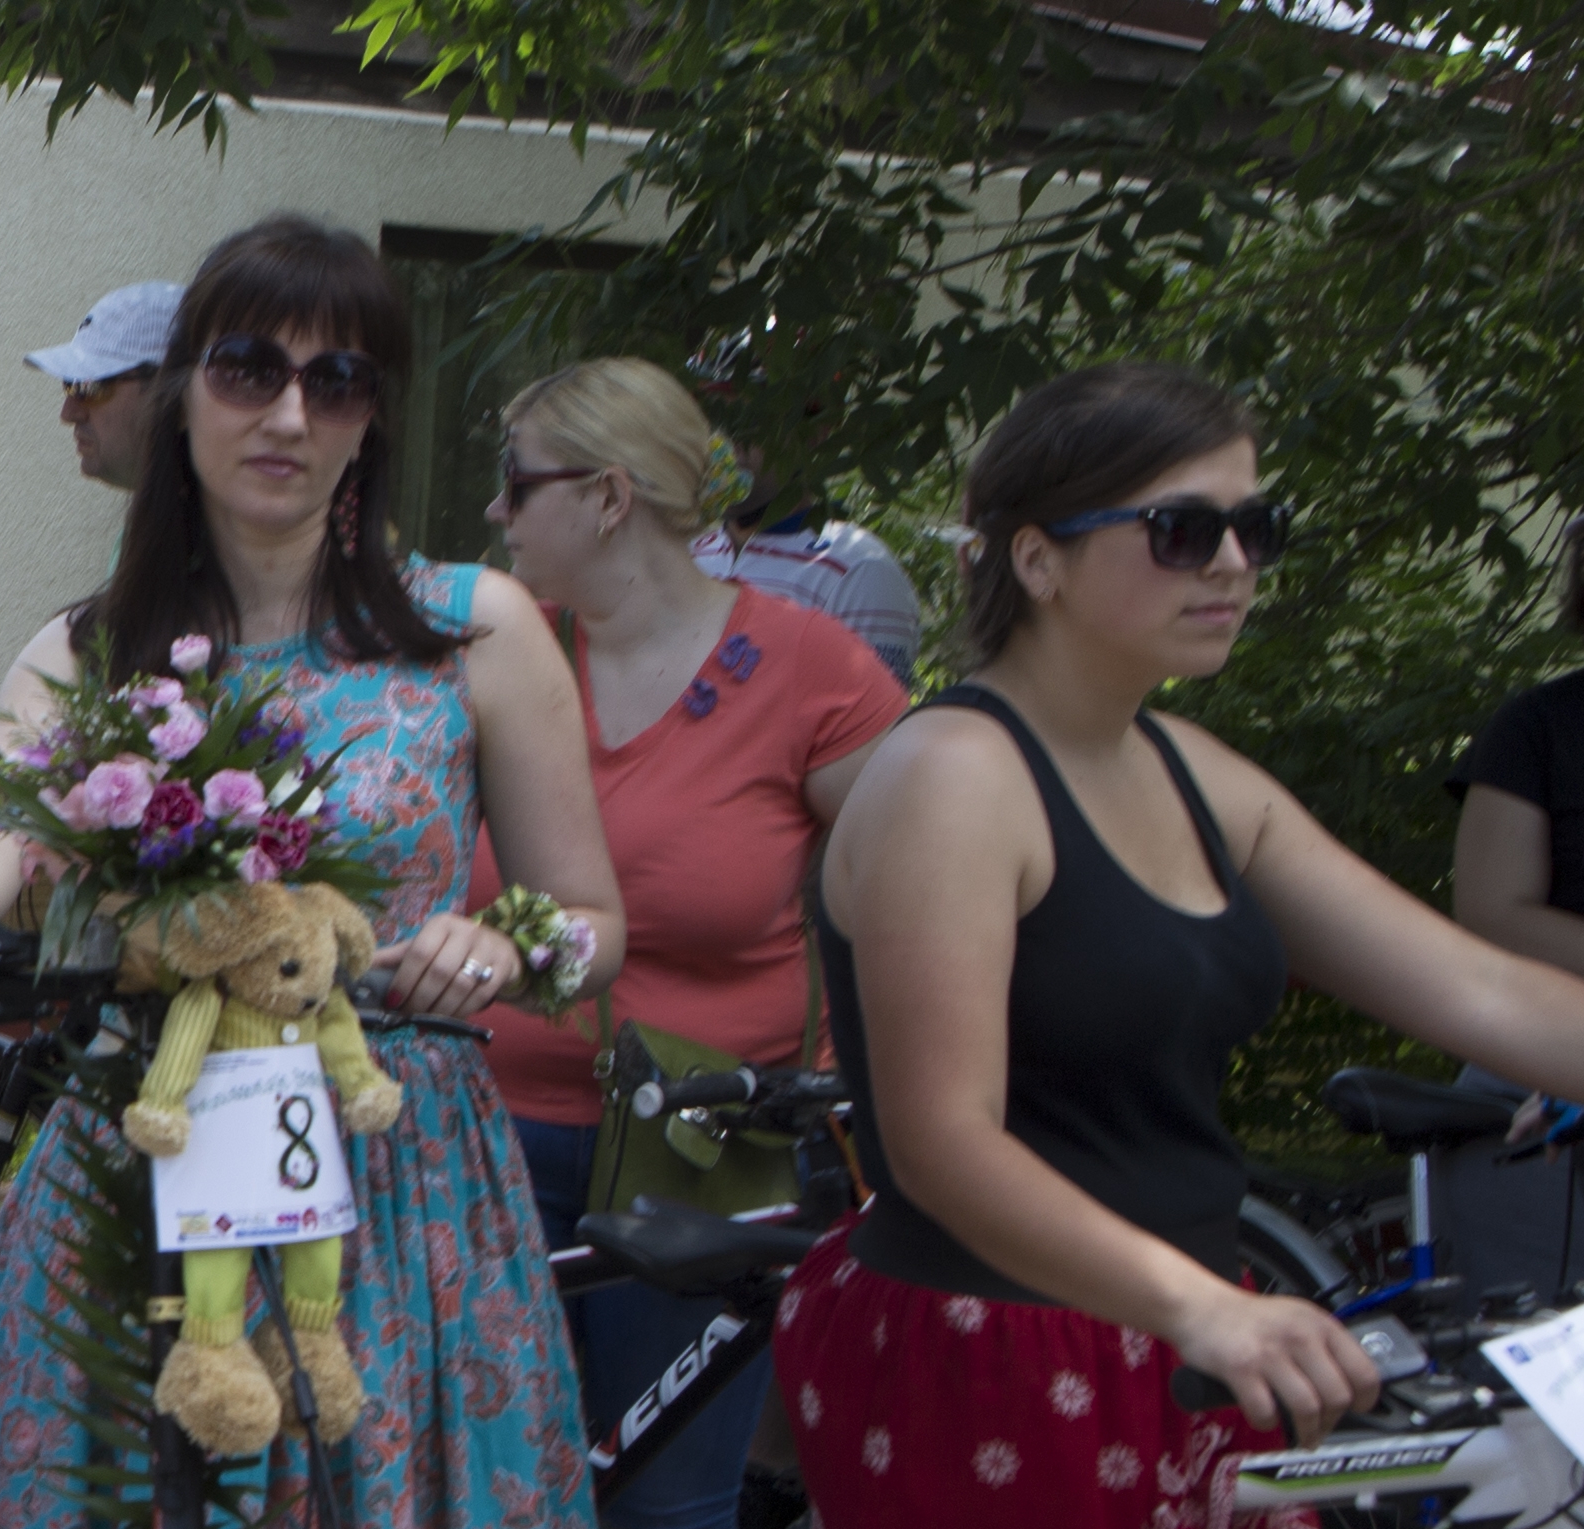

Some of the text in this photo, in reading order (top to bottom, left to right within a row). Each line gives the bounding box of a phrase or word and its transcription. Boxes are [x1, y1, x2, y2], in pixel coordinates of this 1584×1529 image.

[277, 1095, 320, 1191] 8
[1276, 1447, 1449, 1480] PRO RIDER
